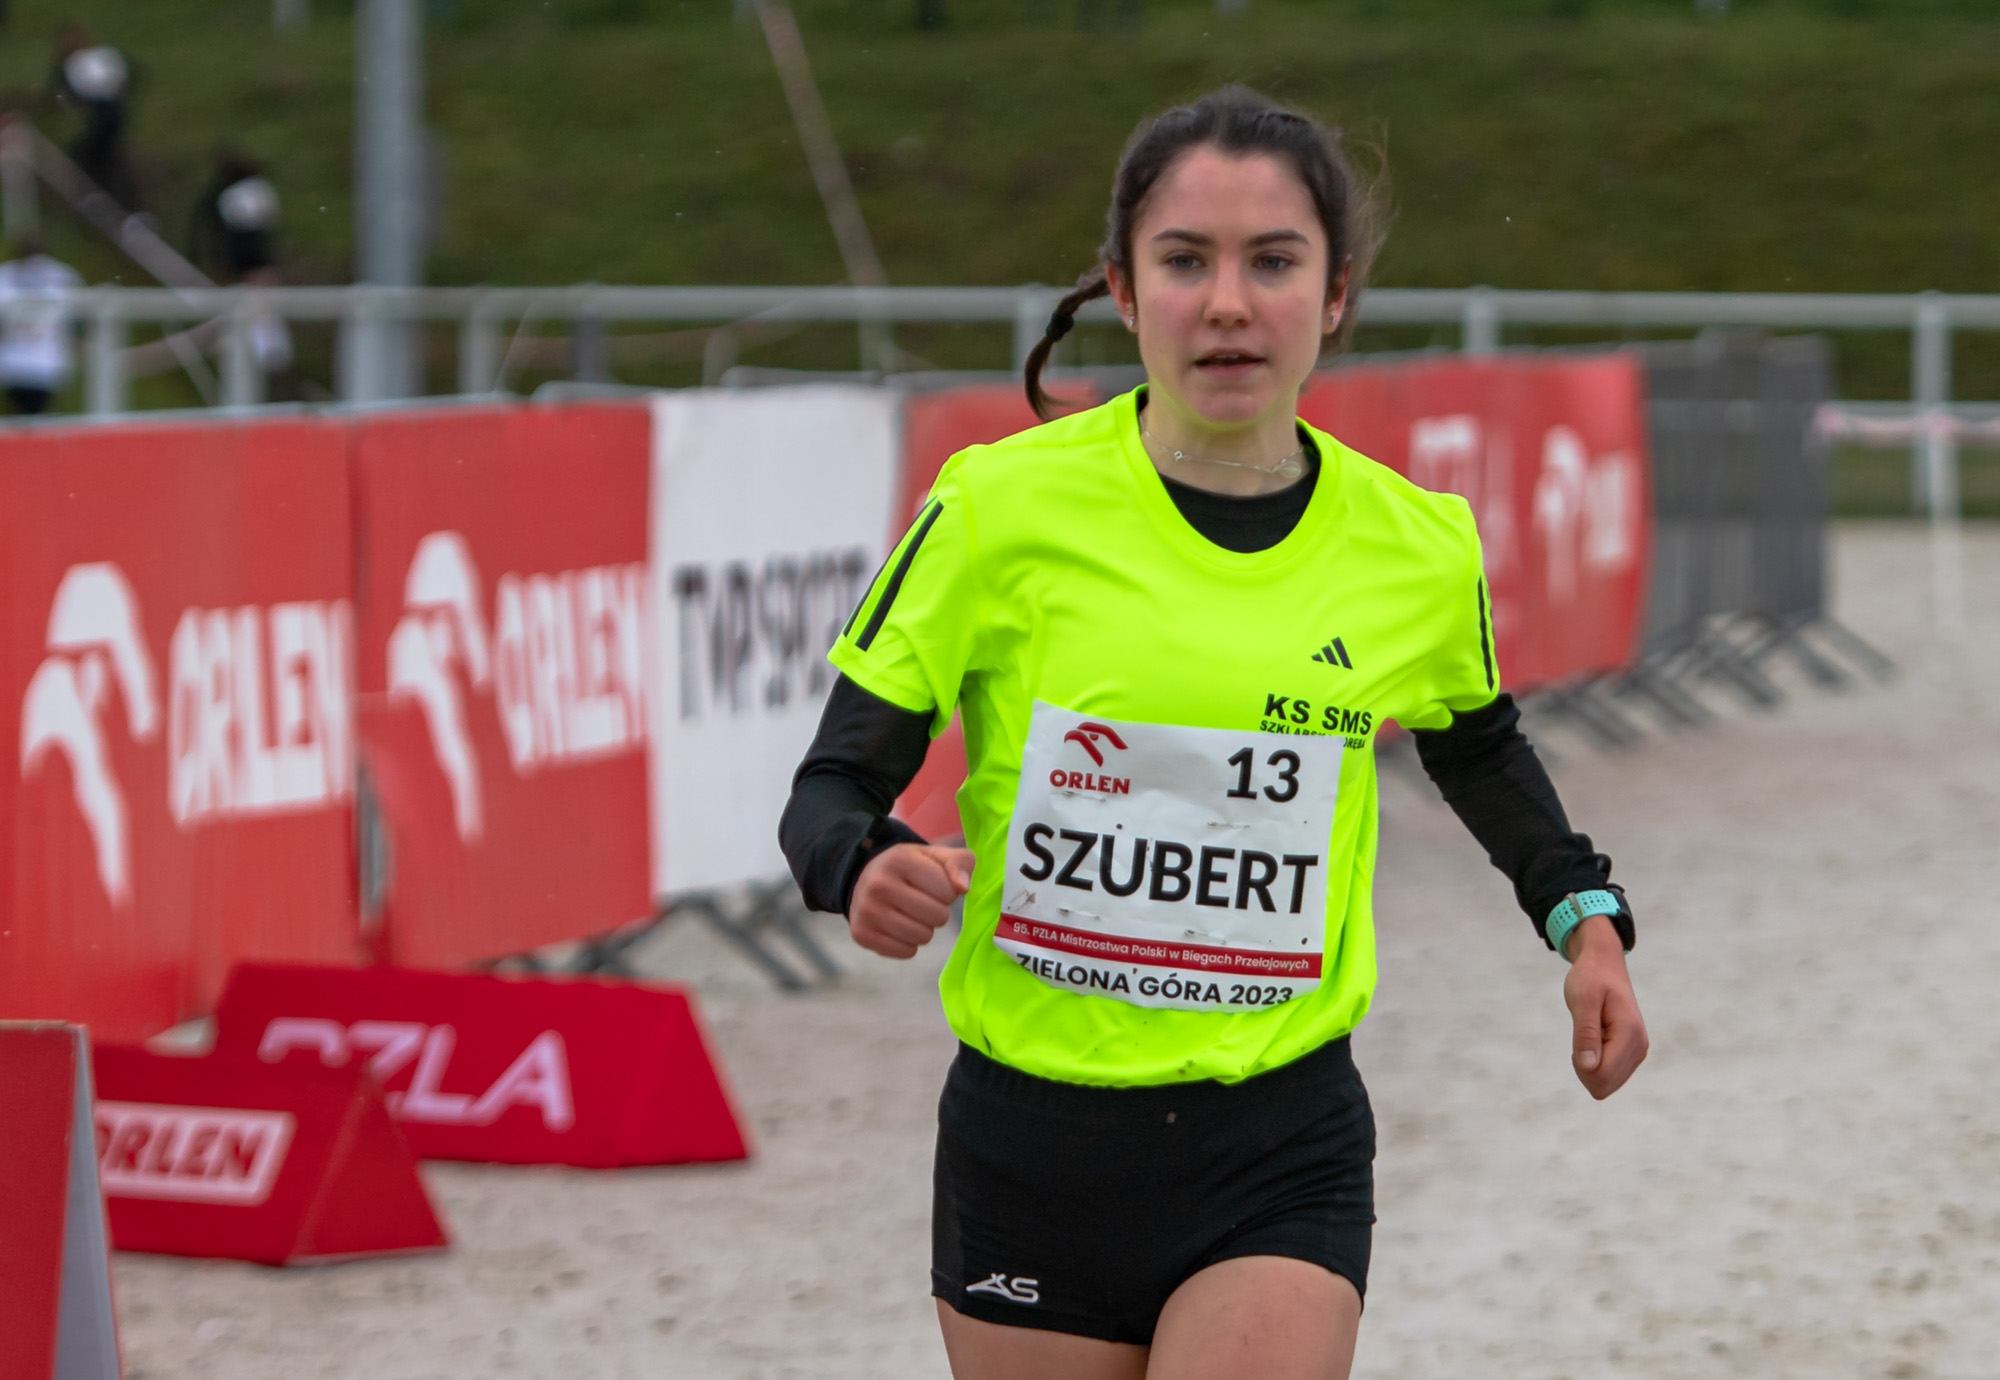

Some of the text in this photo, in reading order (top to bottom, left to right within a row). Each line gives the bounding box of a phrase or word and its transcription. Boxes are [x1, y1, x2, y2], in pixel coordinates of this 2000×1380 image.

[495, 561, 650, 775] ORLEN
[168, 599, 352, 828] ORLEN
[1259, 719, 1333, 736] SZKLAR
[1264, 693, 1373, 735] KS SMS
[1049, 769, 1131, 795] ORLEN
[1226, 747, 1301, 803] 13
[1019, 822, 1319, 914] SZUBERT
[1013, 921, 1310, 972] 95. PZLA Mistrzostwa Polski w Biegach Przełajowych
[1016, 953, 1293, 1005] ZIELONA GÓRA 2023
